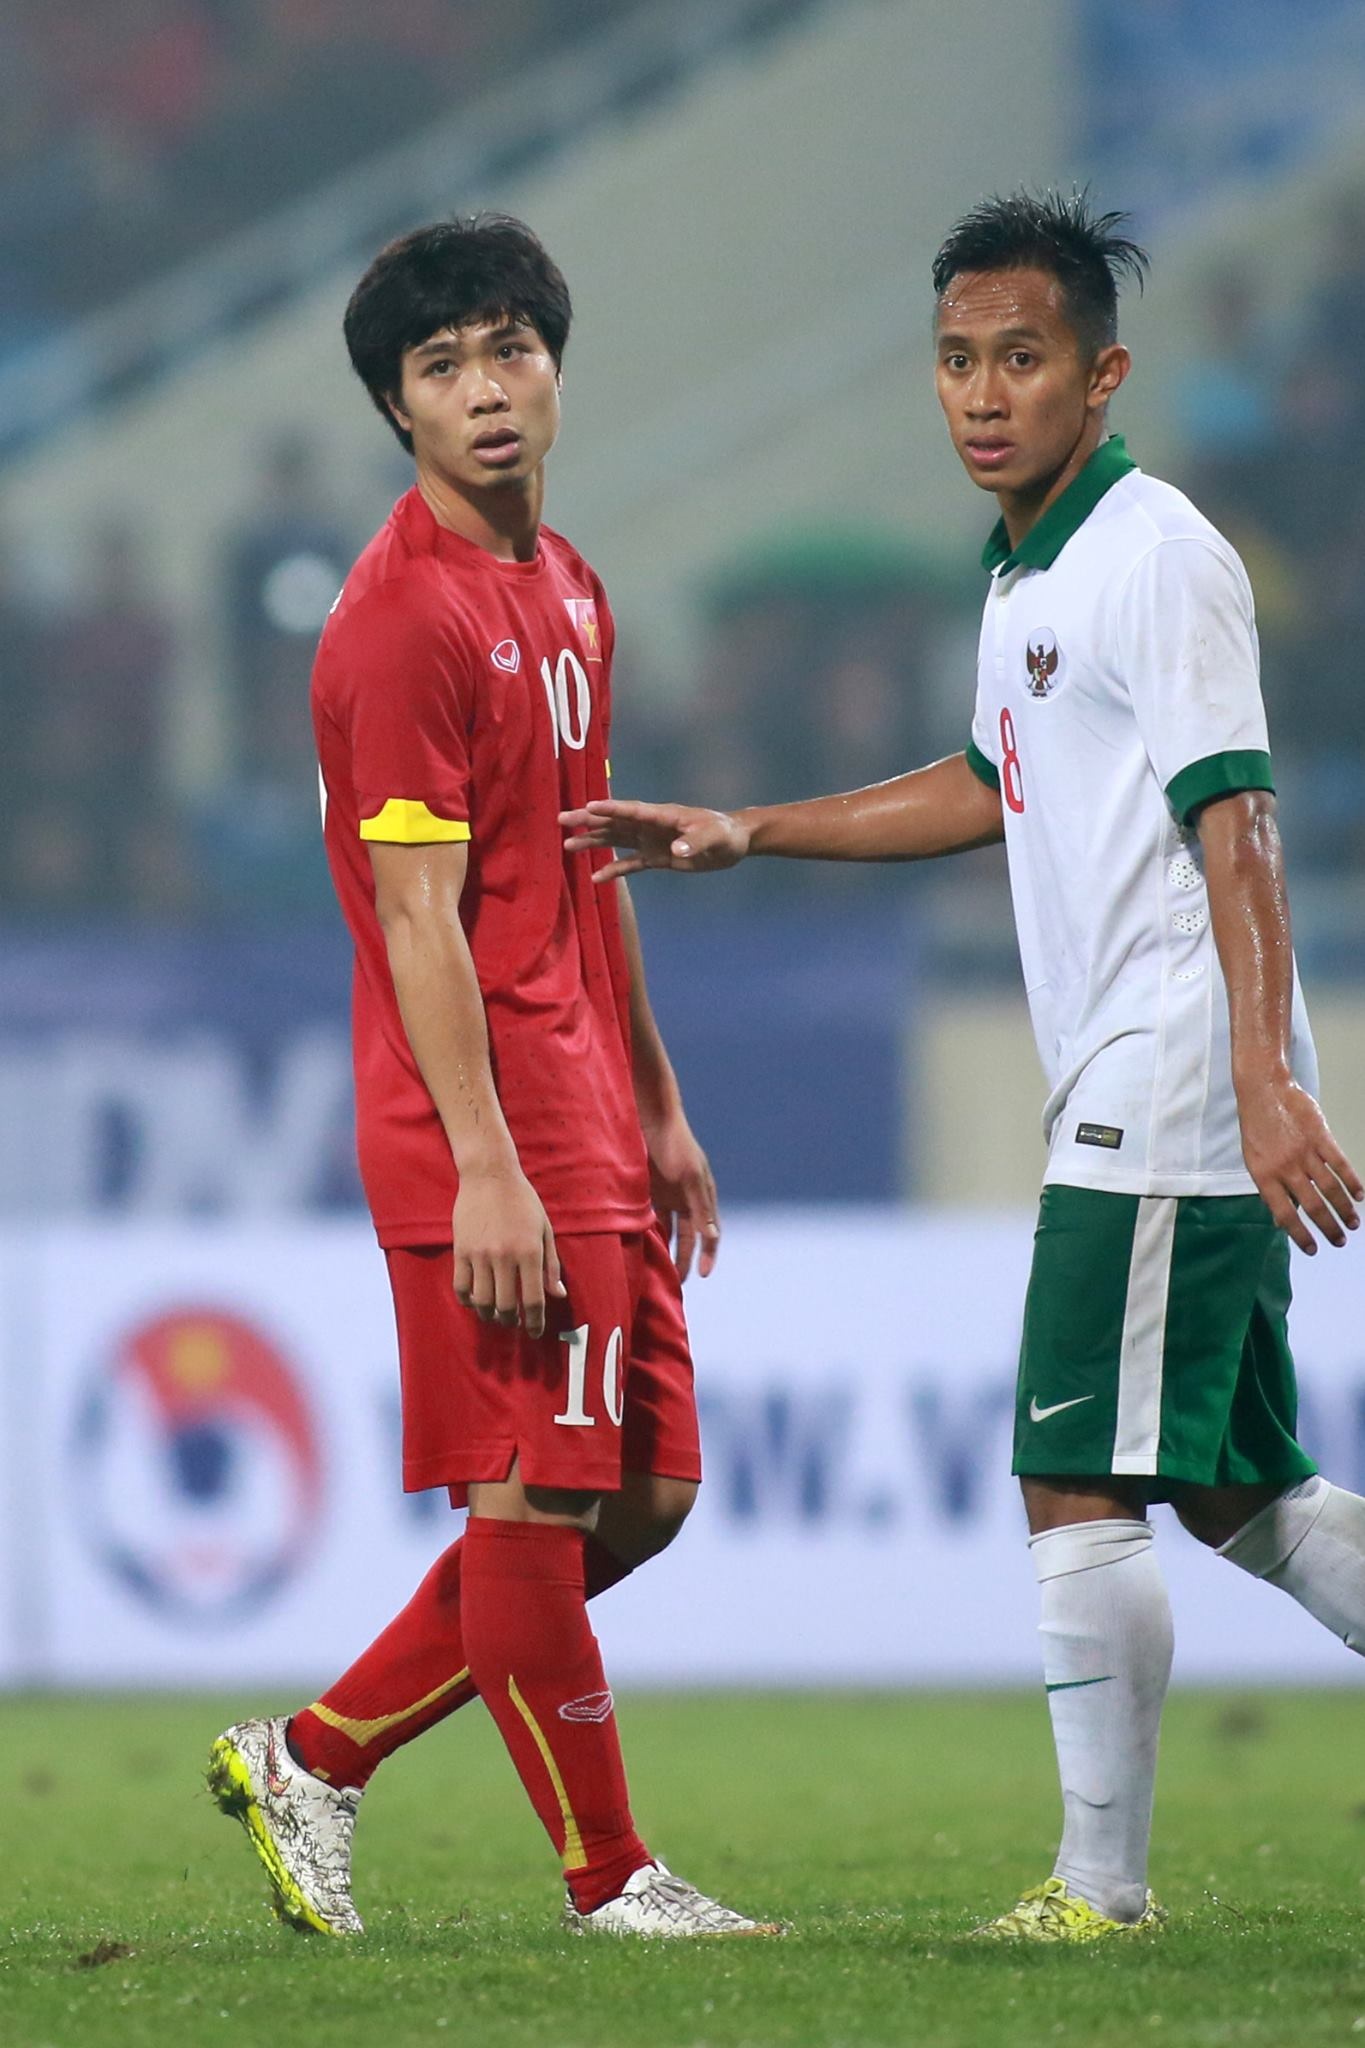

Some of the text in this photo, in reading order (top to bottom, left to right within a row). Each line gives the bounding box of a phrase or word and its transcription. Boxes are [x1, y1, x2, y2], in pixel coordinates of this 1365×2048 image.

[540, 648, 592, 760] 10
[1000, 707, 1025, 814] 8
[554, 1323, 624, 1427] 10
